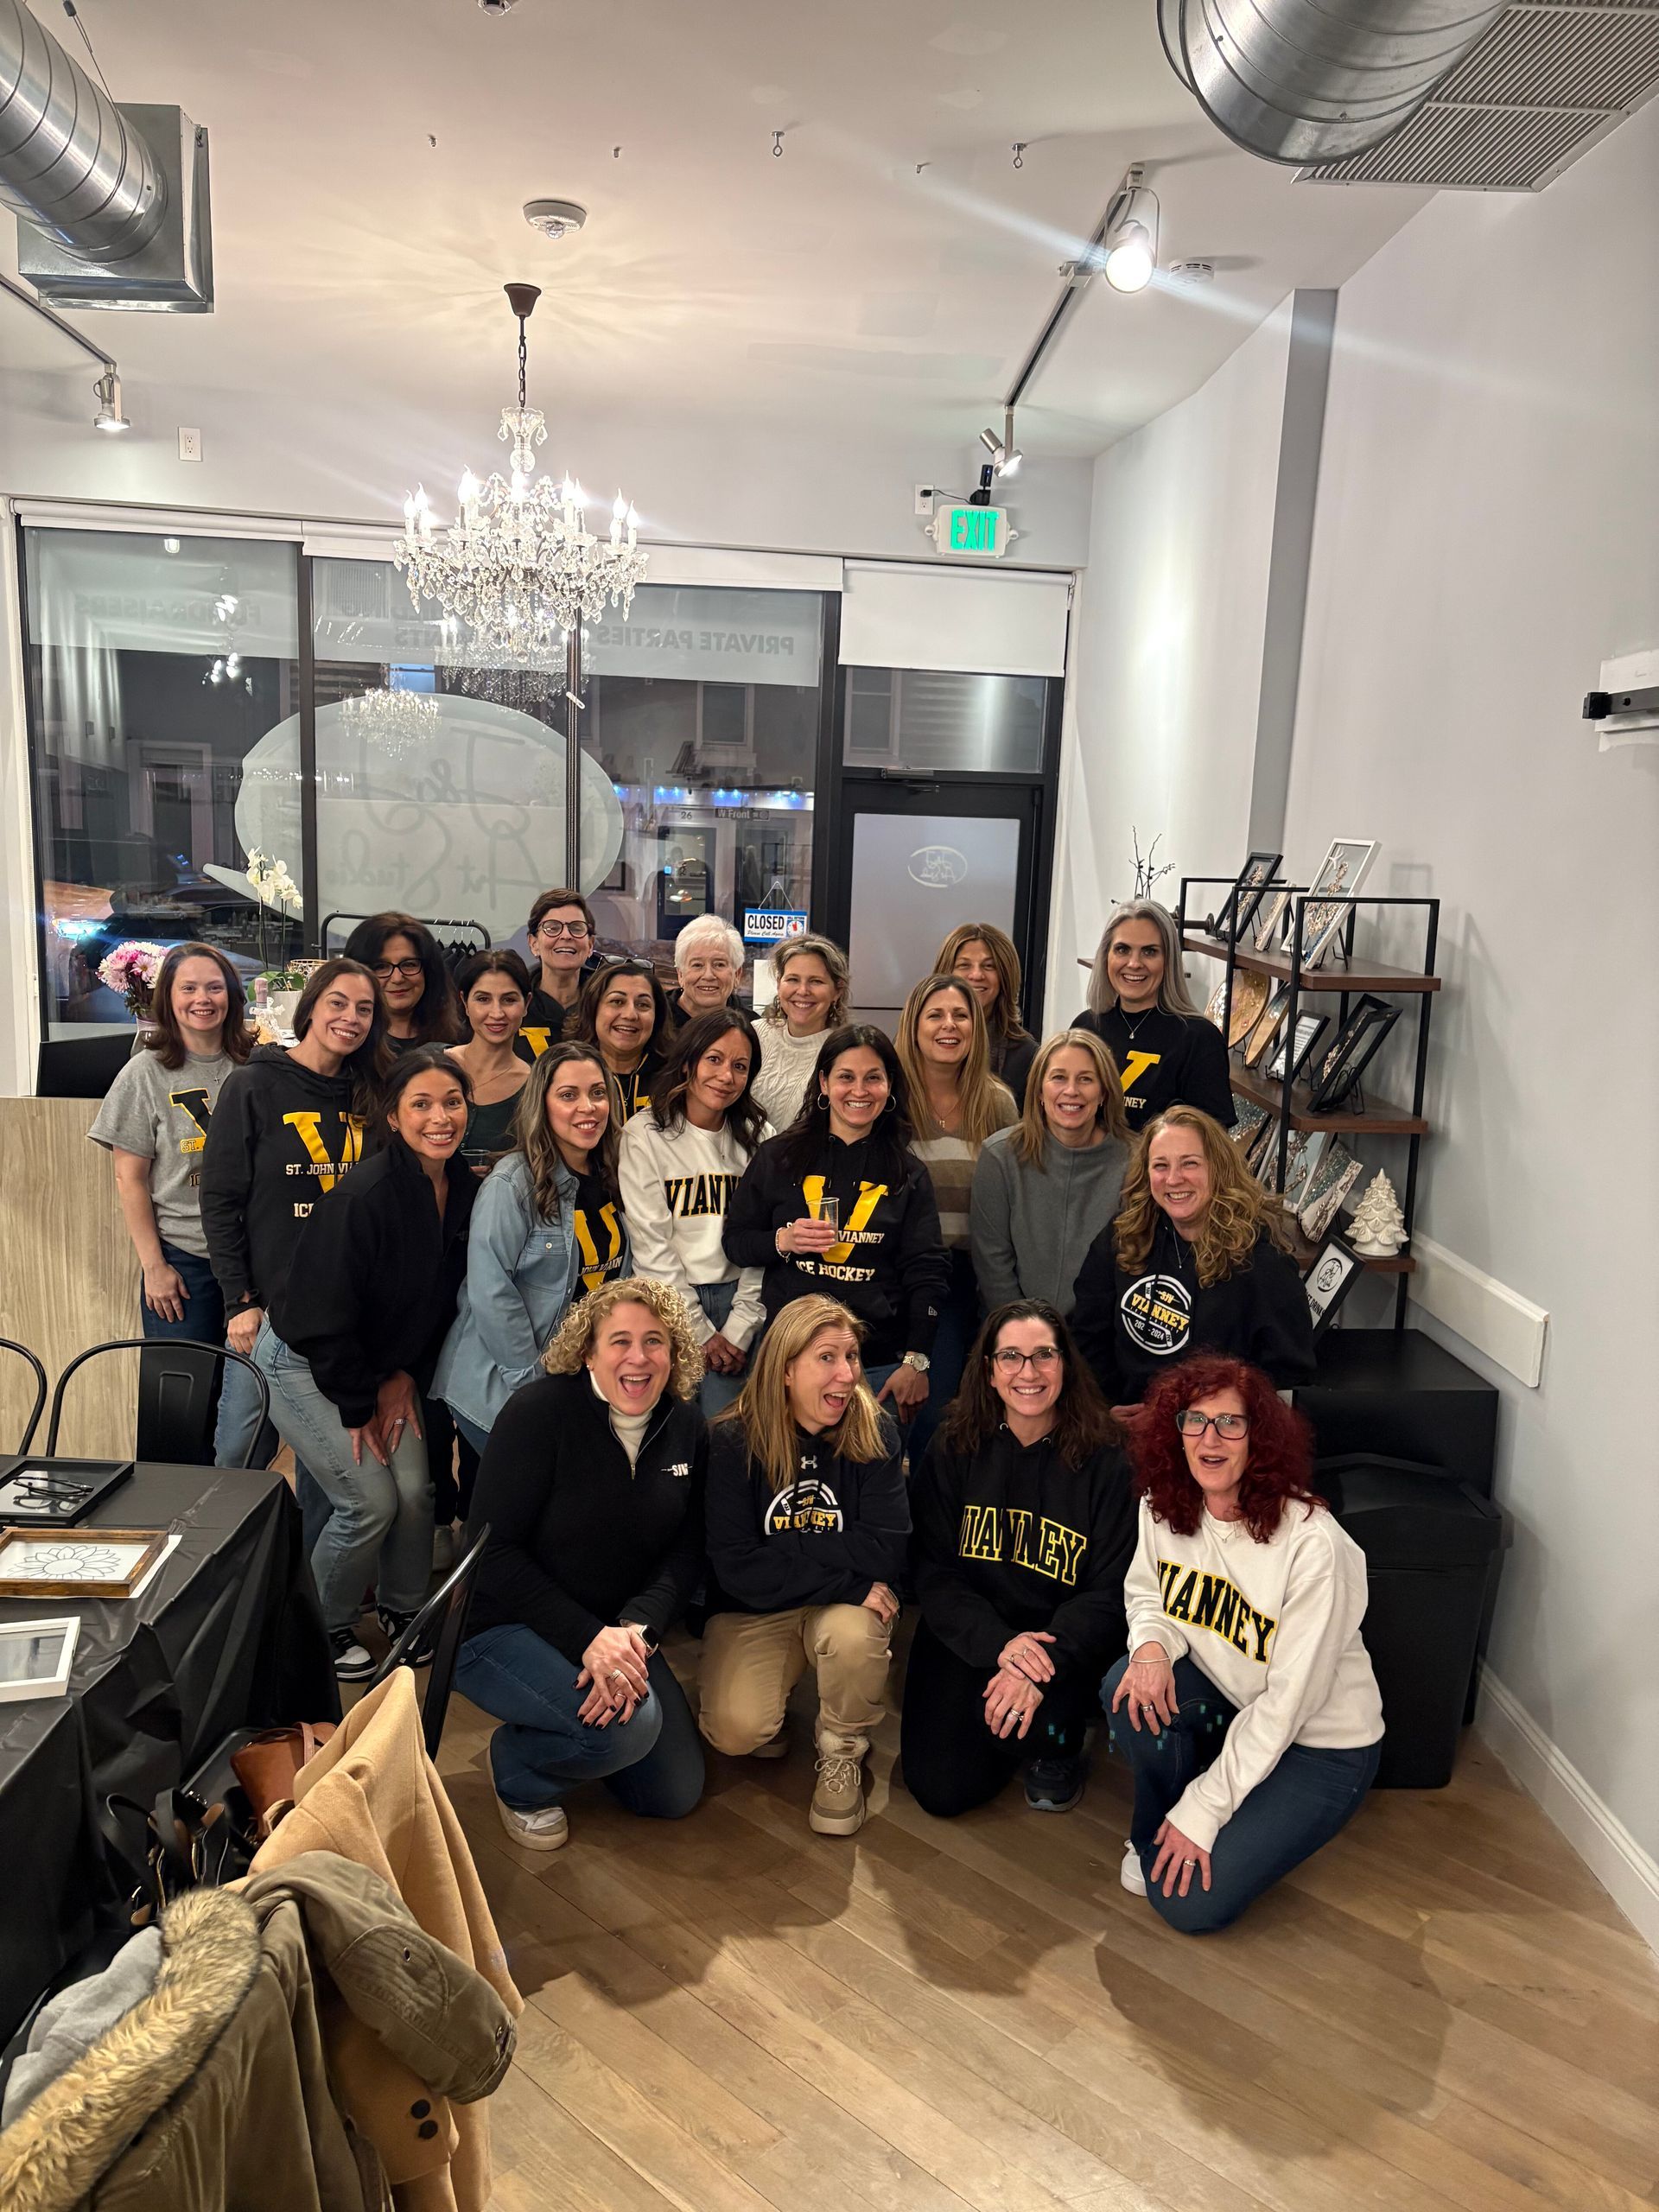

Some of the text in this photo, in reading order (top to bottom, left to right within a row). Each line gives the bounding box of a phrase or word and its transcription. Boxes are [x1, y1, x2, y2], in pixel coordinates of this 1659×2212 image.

[951, 509, 999, 551] EXIT
[681, 810, 692, 820] 26
[718, 808, 727, 818] W
[728, 809, 750, 820] Front
[747, 914, 785, 930] CLOSED
[181, 1140, 200, 1152] ST.
[285, 1163, 304, 1175] ST.
[307, 1163, 334, 1175] JOHN
[838, 1230, 885, 1243] VIANNEY
[817, 1263, 875, 1282] HOCKEY
